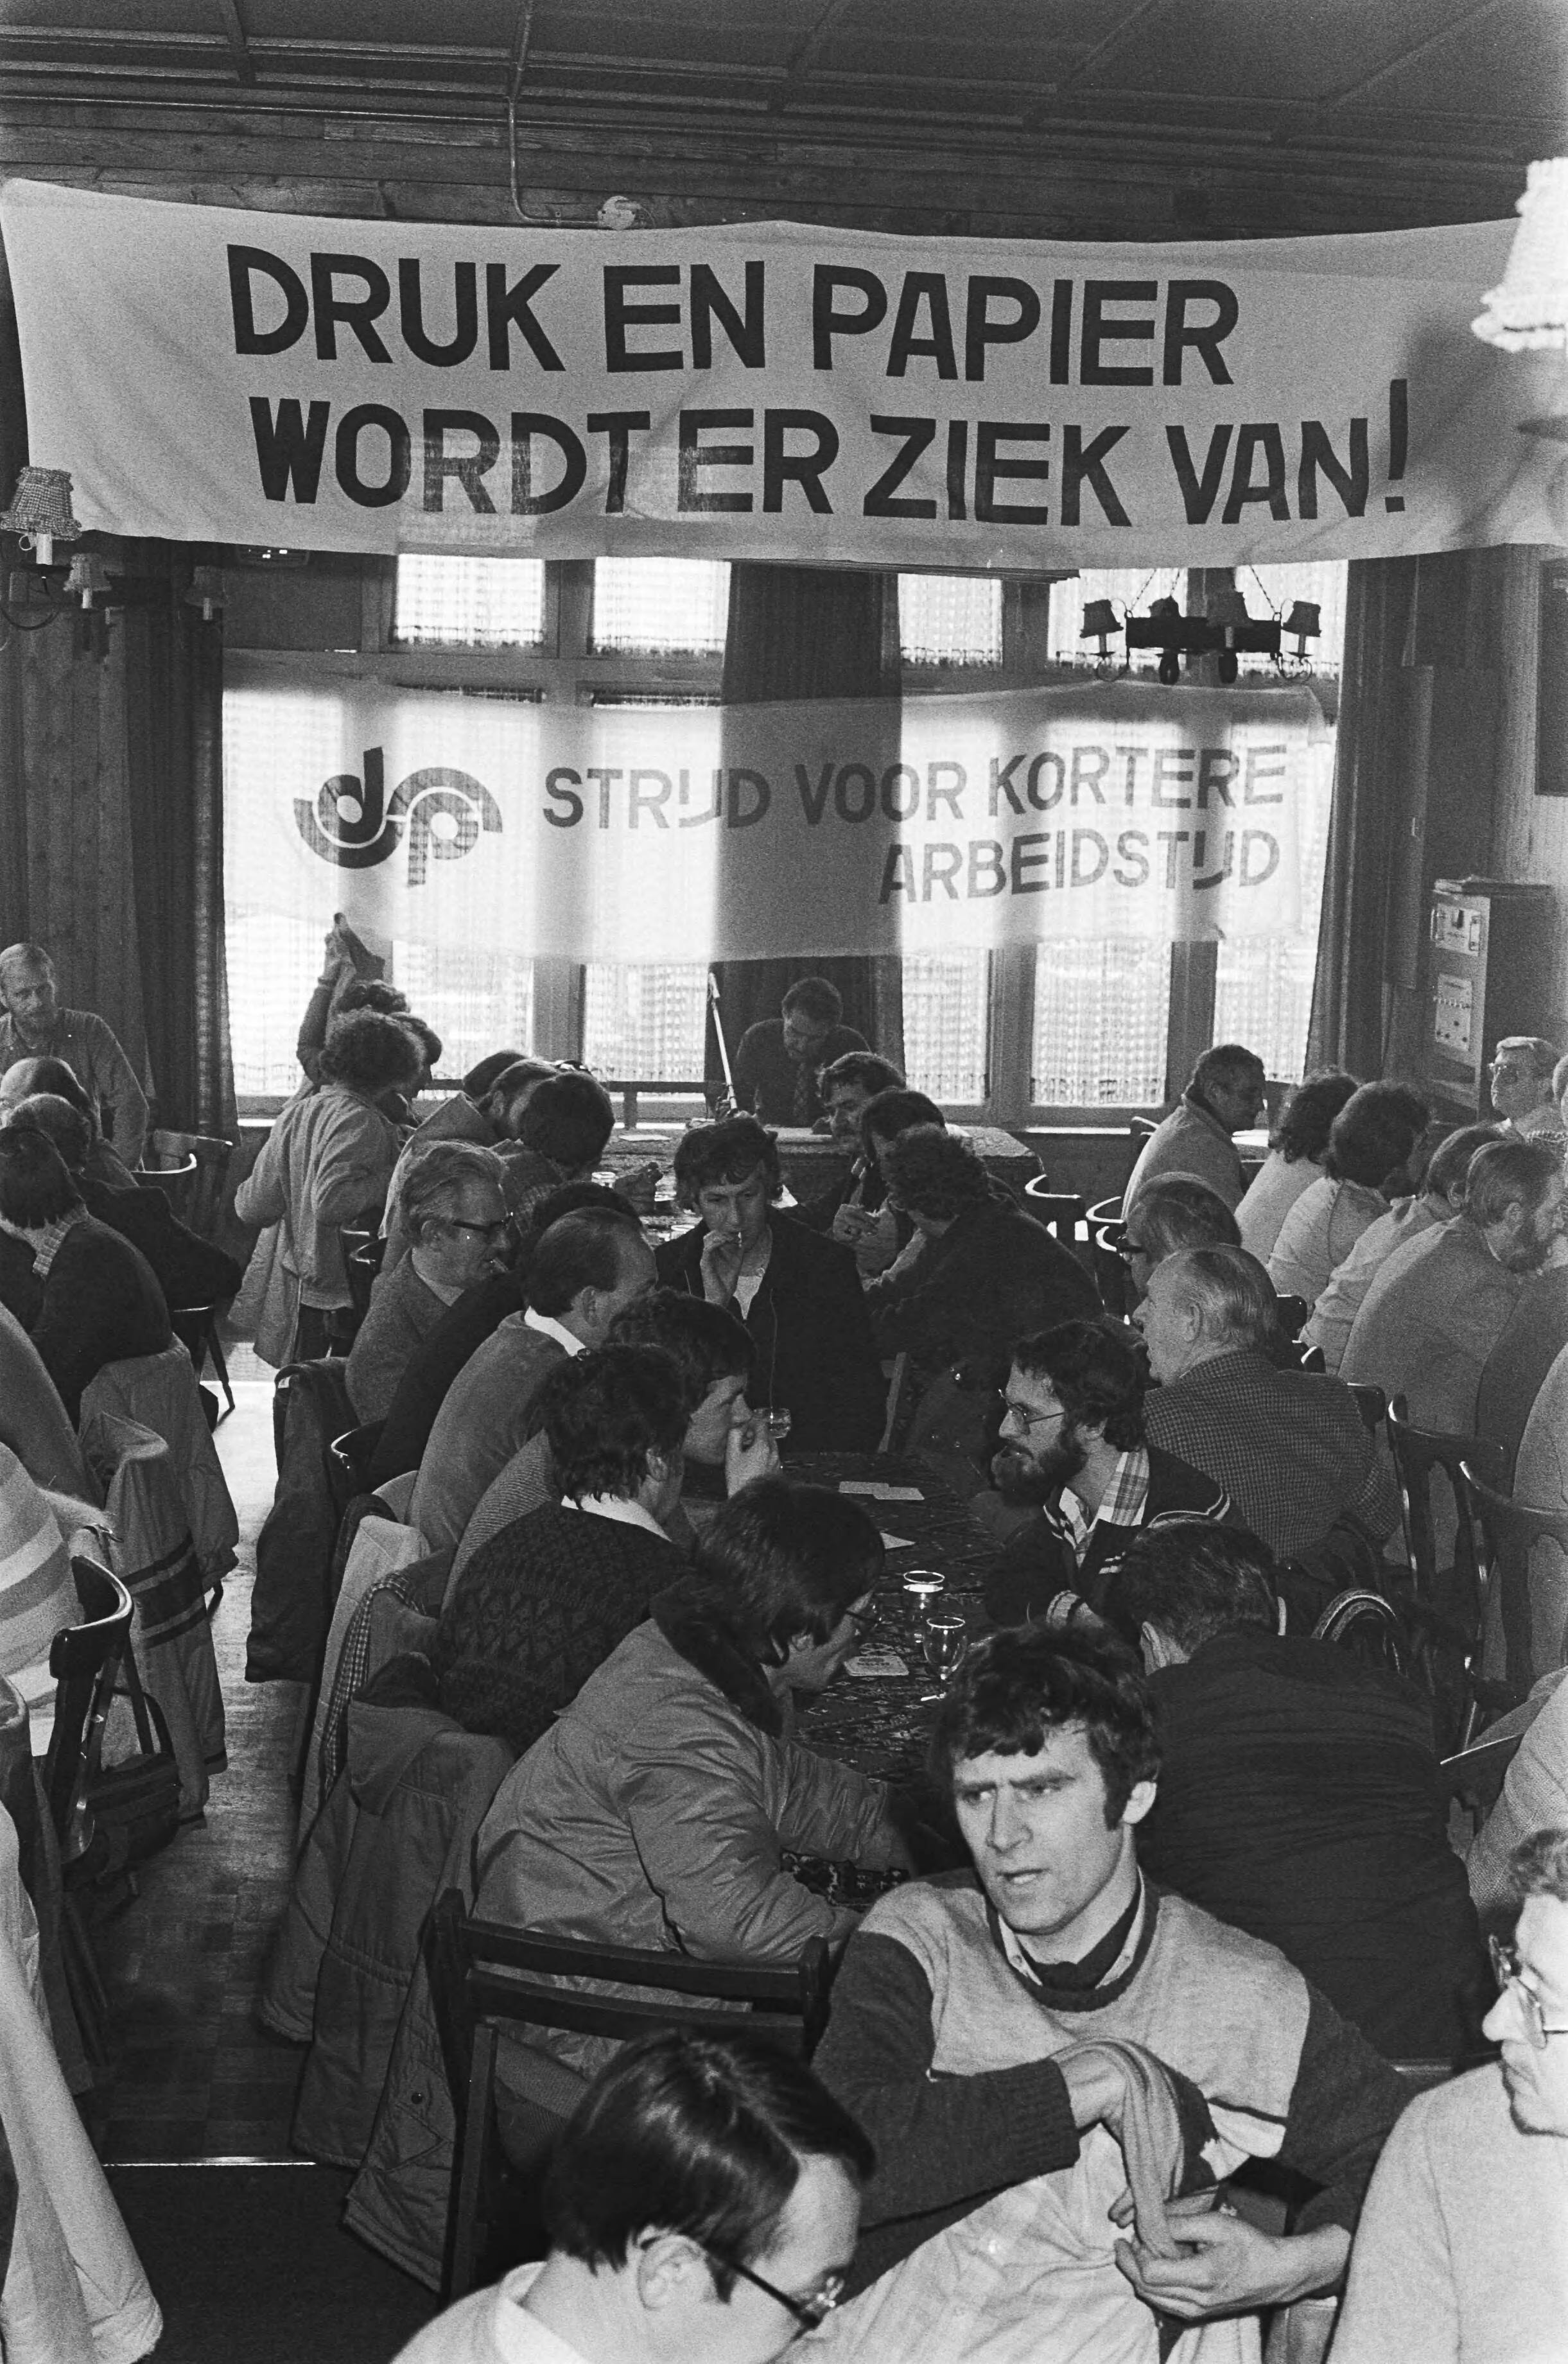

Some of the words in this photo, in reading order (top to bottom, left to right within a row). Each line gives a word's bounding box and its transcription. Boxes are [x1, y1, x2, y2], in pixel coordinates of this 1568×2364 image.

[227, 244, 566, 371] DRUK
[603, 260, 765, 373] EN
[812, 263, 1239, 386] PAPIER
[249, 396, 650, 516] WORDT
[678, 408, 839, 514] ER
[863, 413, 1132, 527] ZIEK
[1165, 378, 1407, 525] VAN!
[543, 767, 771, 830] STRIJD
[794, 761, 968, 825] VOOR
[988, 744, 1287, 817] KORTERE
[878, 829, 1280, 905] ARBEIDSTIJD
